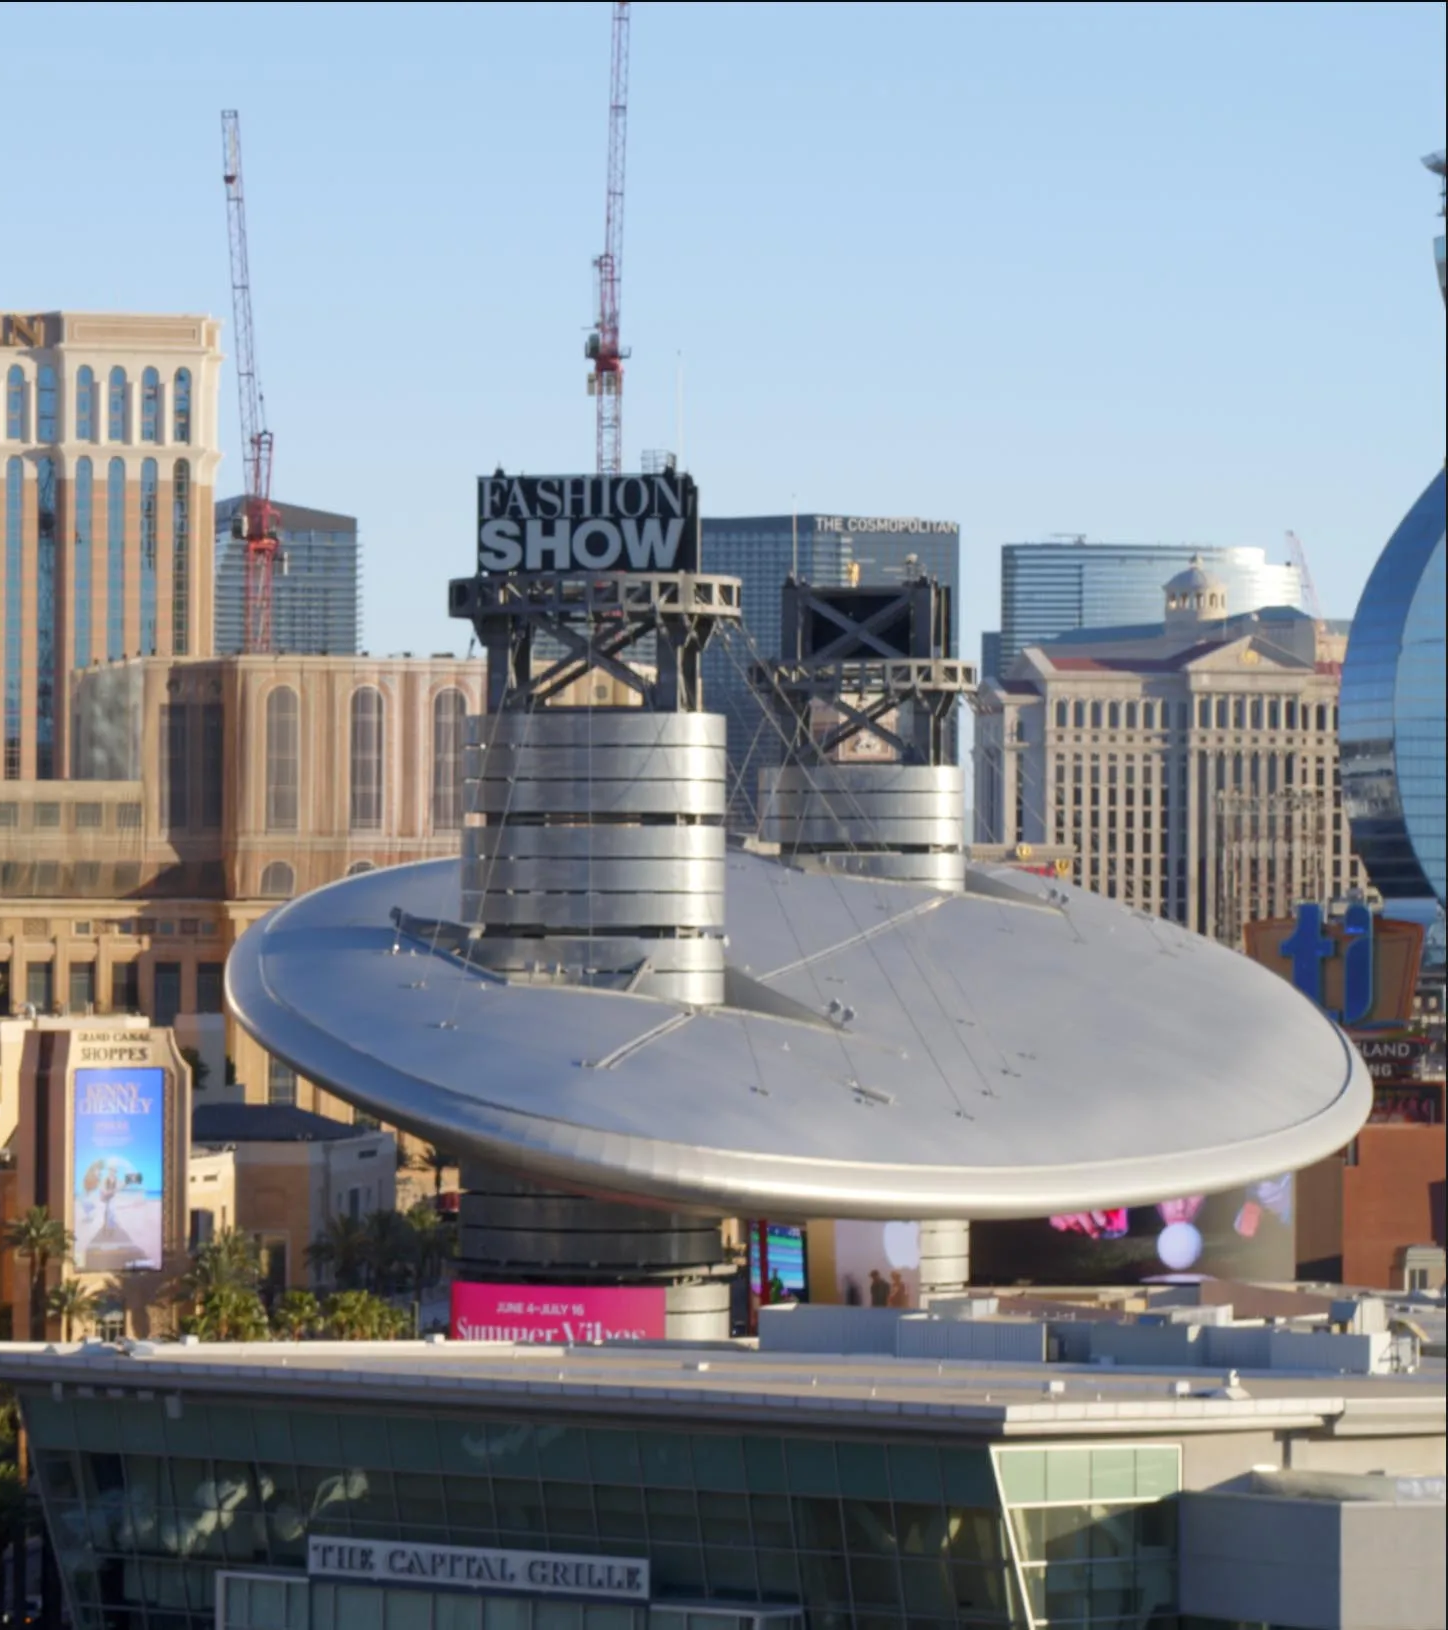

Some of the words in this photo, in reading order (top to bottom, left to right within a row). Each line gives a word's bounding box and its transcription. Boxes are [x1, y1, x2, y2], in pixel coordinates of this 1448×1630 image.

[481, 477, 688, 519] FASHION
[814, 516, 843, 532] THE
[847, 518, 958, 534] COSMOPOLITAN
[479, 518, 685, 570] SHOW
[81, 1046, 148, 1061] SHOPPES
[86, 1082, 140, 1099] KENNY
[496, 1302, 524, 1315] JUNE
[456, 1316, 558, 1342] Summer
[312, 1543, 375, 1571] THE
[387, 1549, 515, 1583] CAPITAL
[528, 1559, 642, 1592] GRILLE
